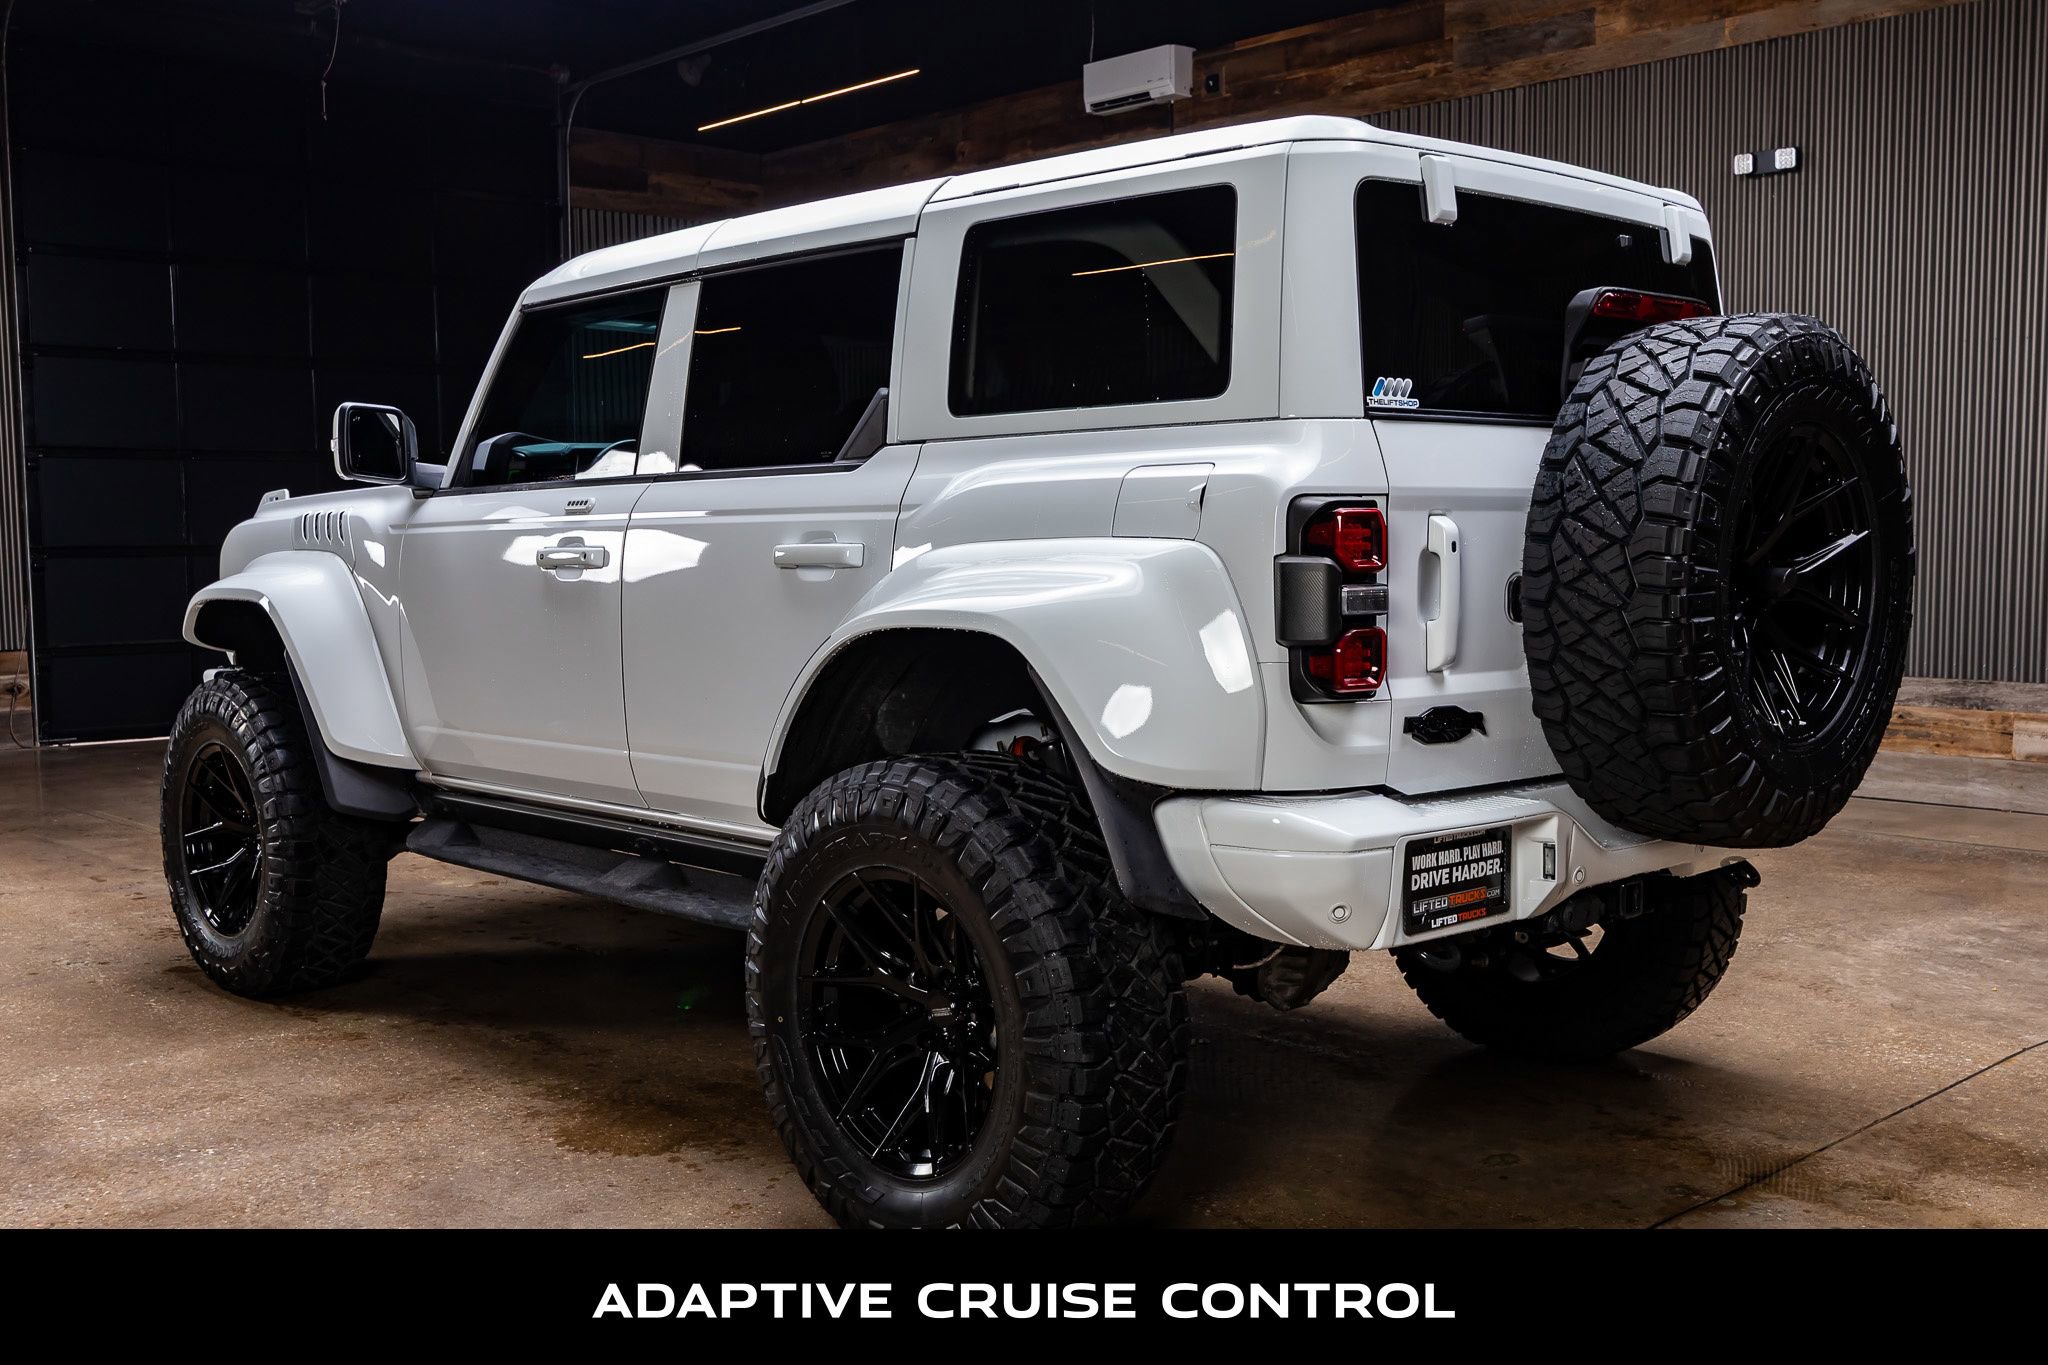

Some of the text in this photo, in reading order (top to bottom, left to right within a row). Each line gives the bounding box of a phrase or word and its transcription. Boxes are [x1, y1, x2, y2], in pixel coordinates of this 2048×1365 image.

[1411, 840, 1504, 871] WORK HARD. PLAY HARD.
[1411, 858, 1504, 891] DRIVE HARDER.
